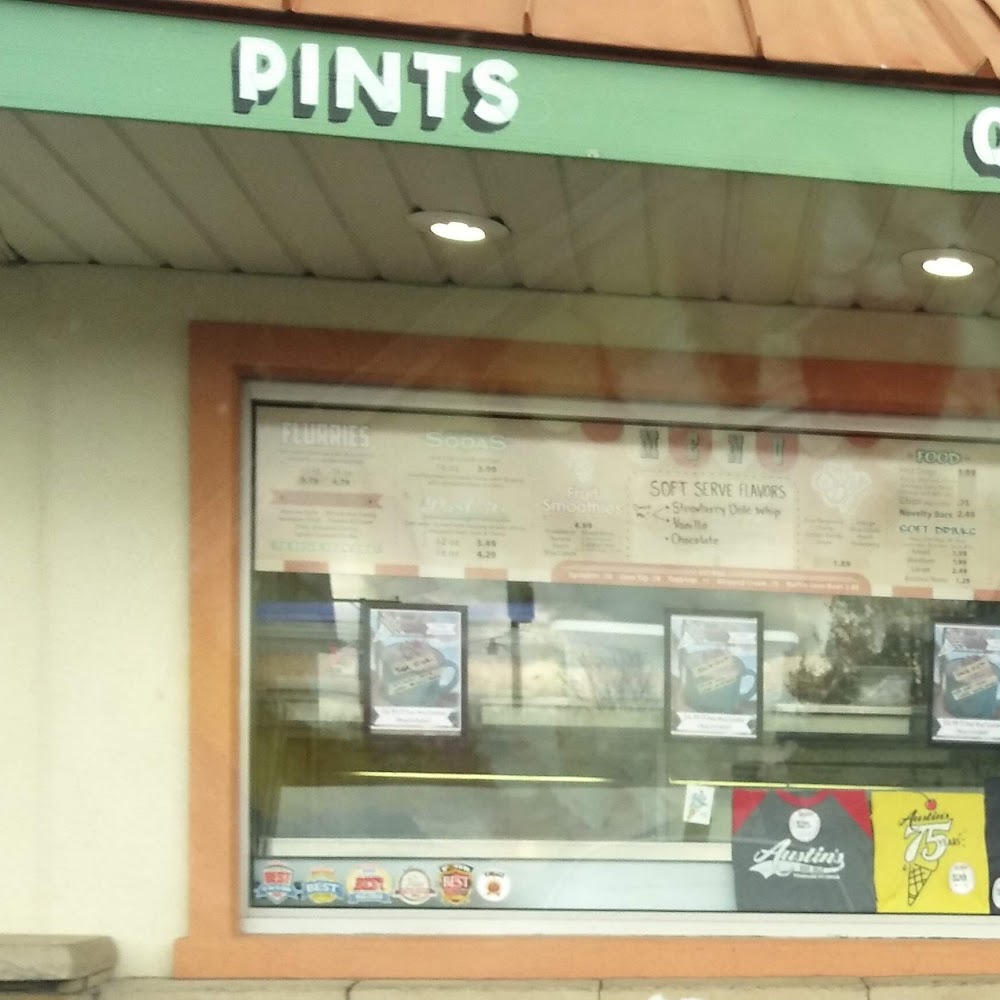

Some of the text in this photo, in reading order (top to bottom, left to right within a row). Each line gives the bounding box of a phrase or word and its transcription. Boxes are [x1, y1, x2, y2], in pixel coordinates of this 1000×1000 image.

[232, 36, 519, 132] PINTS
[281, 422, 370, 447] FLURRIES
[916, 449, 961, 465] FOOD
[650, 480, 786, 499] SOFT SERVE FLAVORS
[899, 510, 932, 519] Novelty
[671, 533, 719, 545] Chocolate
[898, 809, 954, 829] Austin's
[904, 819, 953, 863] 75
[753, 838, 845, 866] Austin's
[306, 882, 338, 893] BEST
